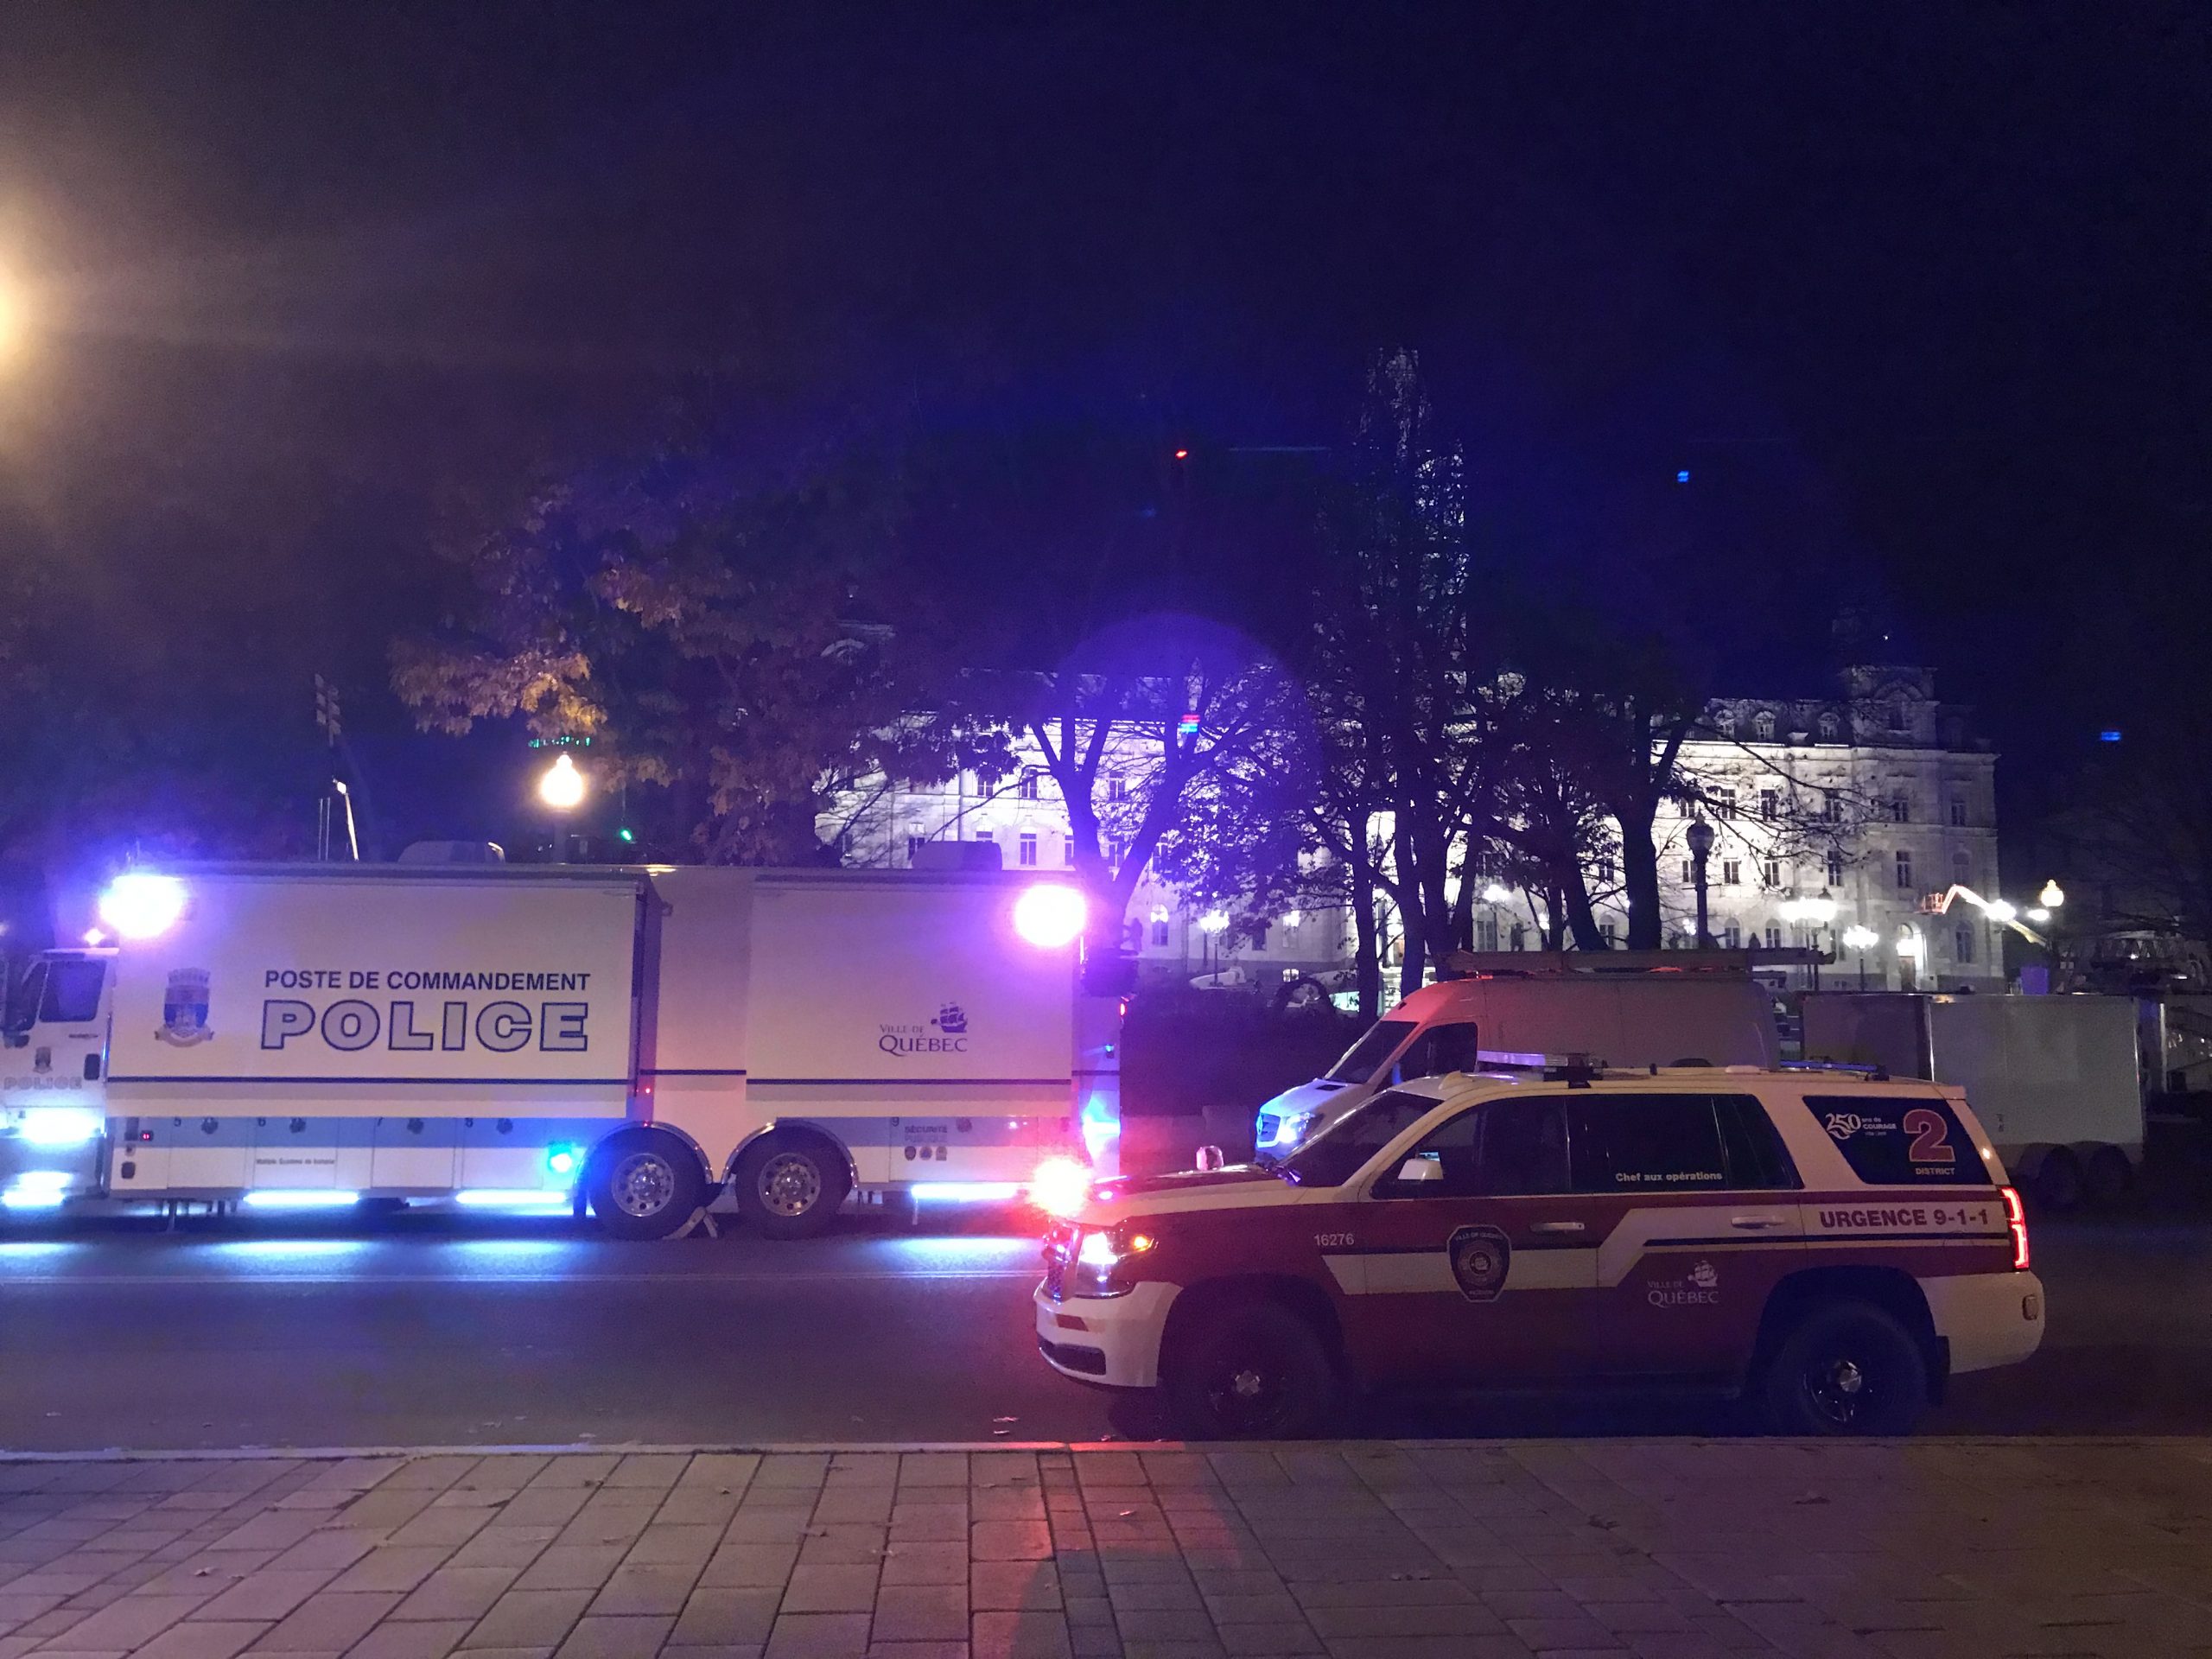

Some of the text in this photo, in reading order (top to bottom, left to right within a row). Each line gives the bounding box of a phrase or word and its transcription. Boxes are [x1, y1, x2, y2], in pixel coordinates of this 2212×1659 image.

[264, 969, 591, 991] POSTE DE COMMANDEMENT
[260, 999, 589, 1052] POLICE
[880, 1024, 925, 1033] VILLE DE
[879, 1033, 968, 1057] QUÉBEC
[3, 1076, 83, 1090] POLICE
[1825, 1112, 1862, 1135] 250
[1904, 1109, 1956, 1162] 2
[1615, 1172, 1641, 1182] Chef
[1665, 1171, 1723, 1183] opérations
[1915, 1167, 1956, 1176] DISTRICT
[1819, 1208, 1988, 1229] URGENCE 9-1-1
[1313, 1233, 1355, 1246] 16276
[1647, 1280, 1671, 1288] VILLE
[1647, 1289, 1719, 1309] QUÉBEC
